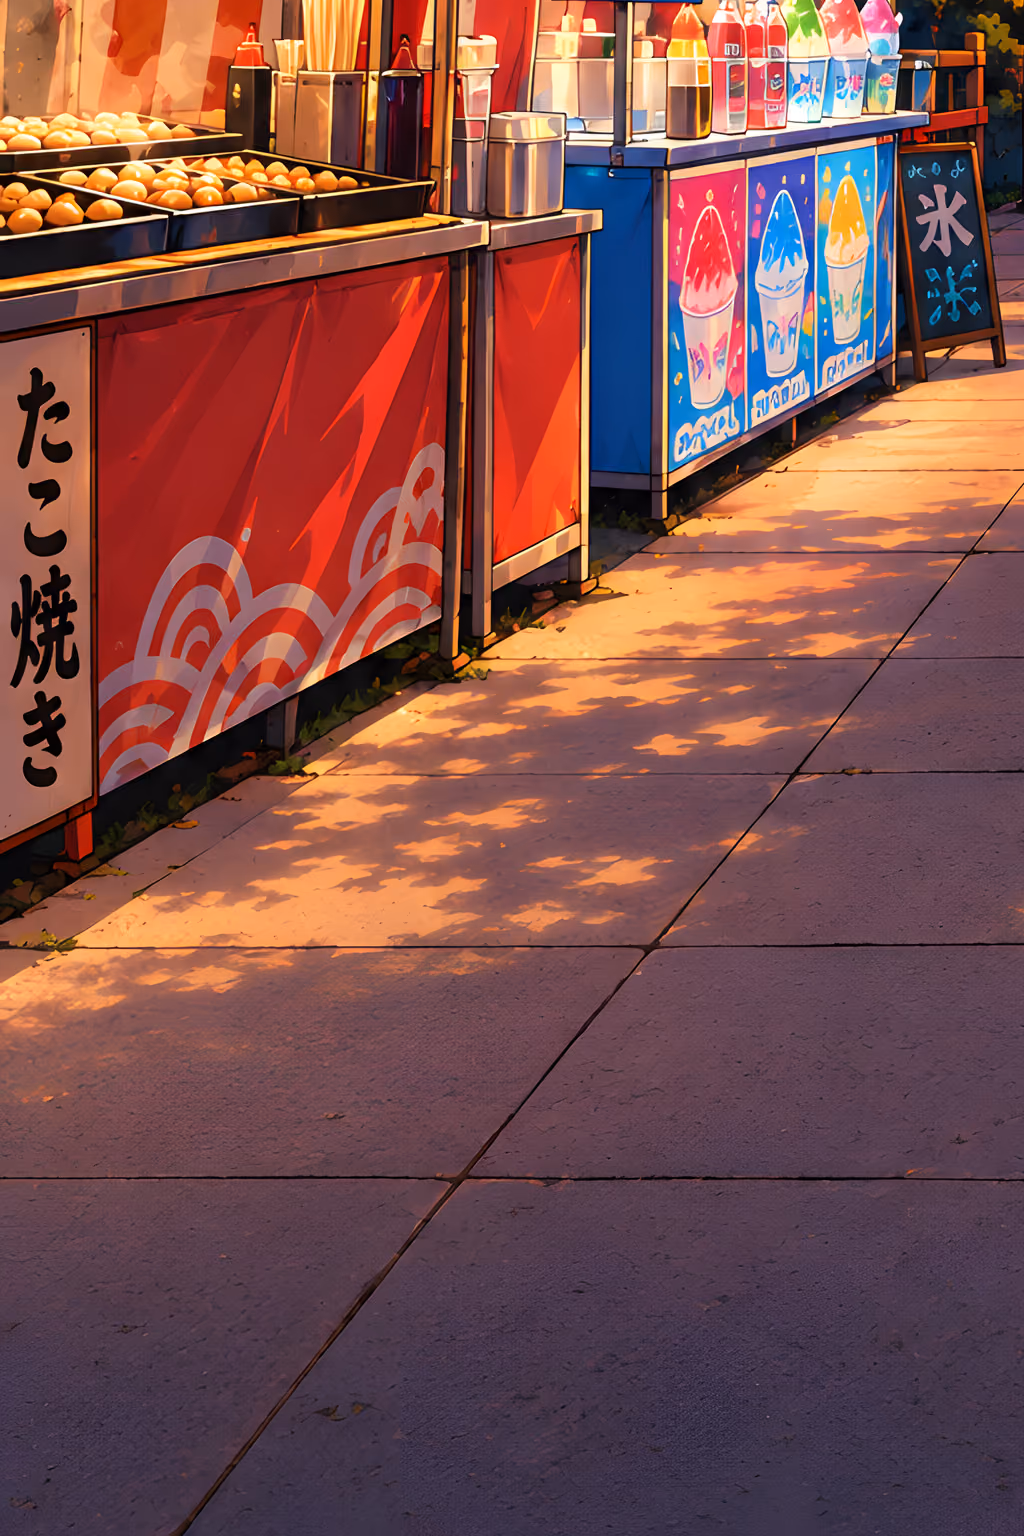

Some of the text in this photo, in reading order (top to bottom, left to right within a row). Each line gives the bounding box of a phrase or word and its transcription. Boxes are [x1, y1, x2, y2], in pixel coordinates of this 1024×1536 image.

[915, 183, 975, 258] 氷
[9, 366, 81, 788] たこ焼き
